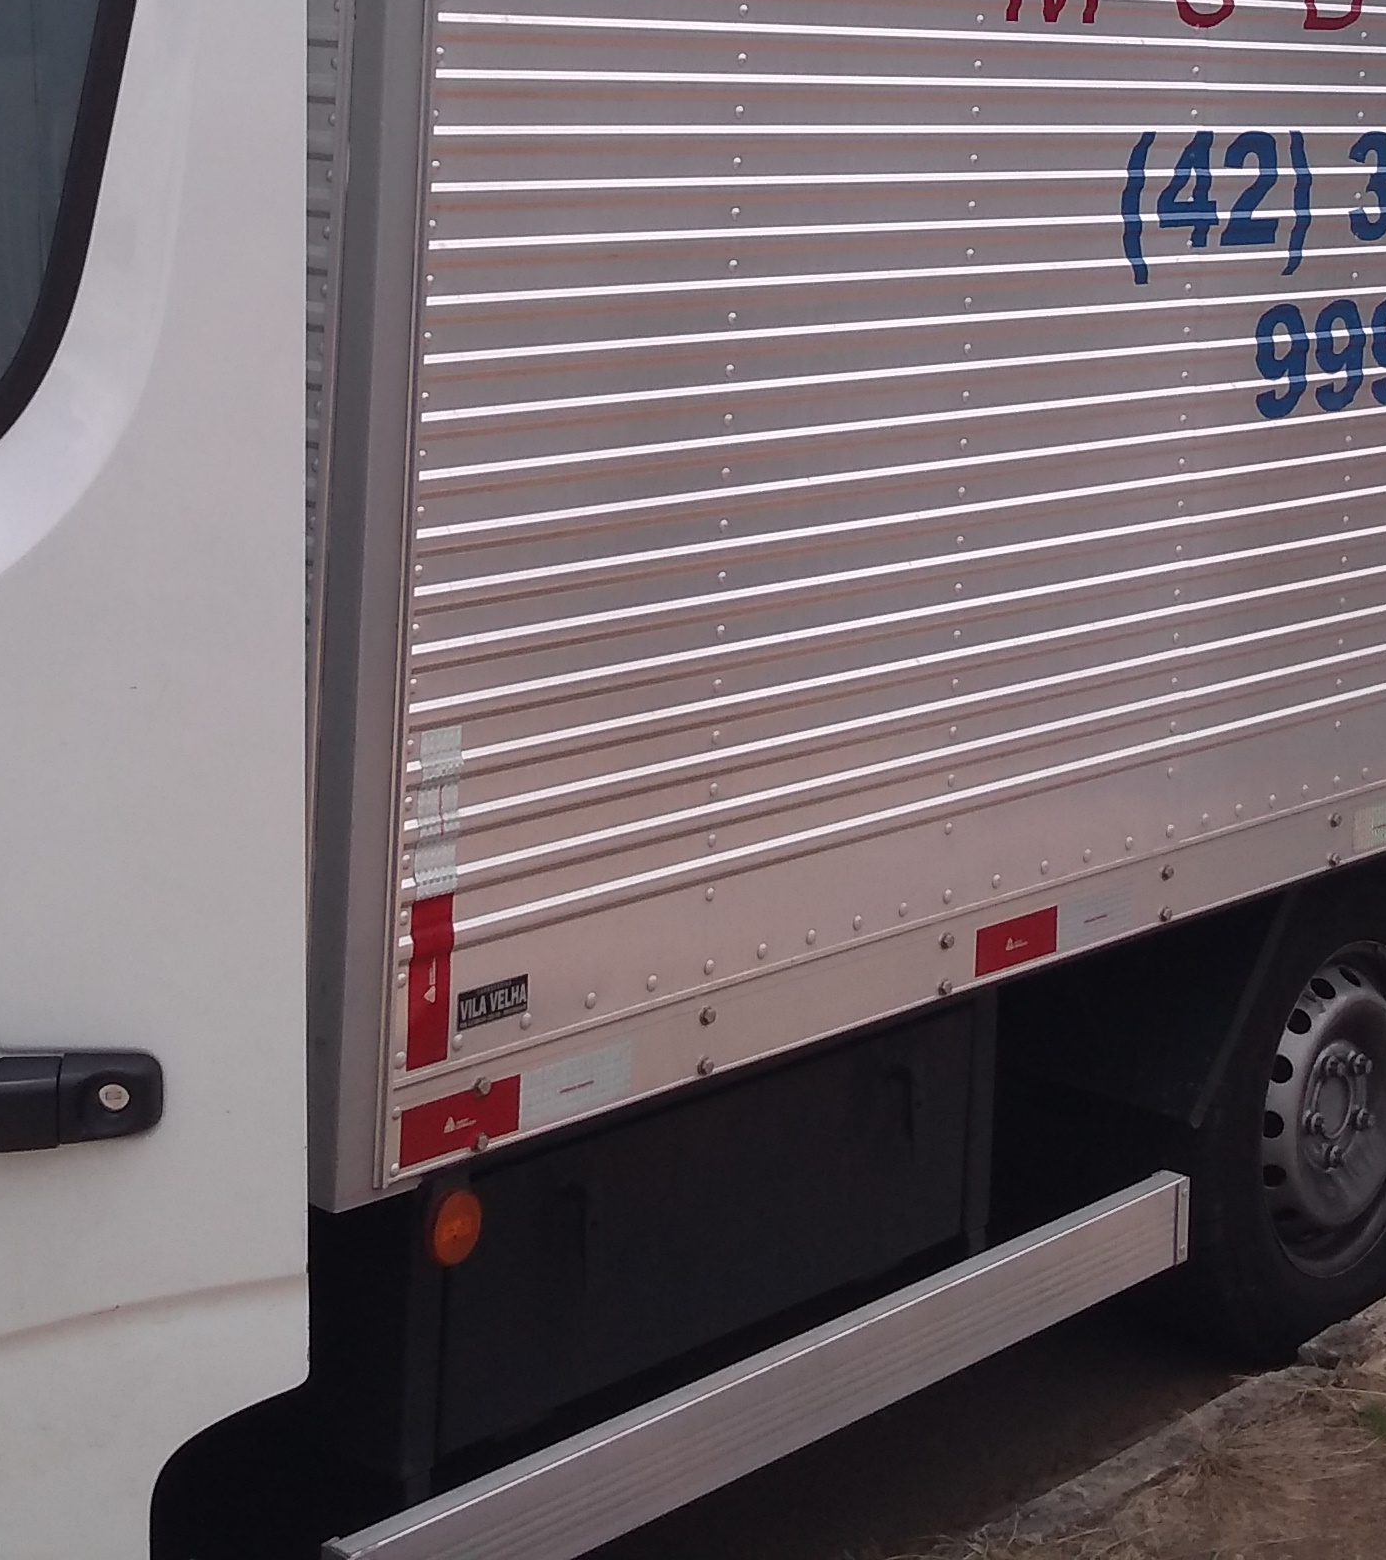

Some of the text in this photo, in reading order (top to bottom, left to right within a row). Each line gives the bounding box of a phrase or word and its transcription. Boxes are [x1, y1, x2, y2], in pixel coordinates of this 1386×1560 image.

[1121, 130, 1312, 284] (42)
[459, 995, 488, 1021] VILA
[489, 983, 528, 1012] VELHA
